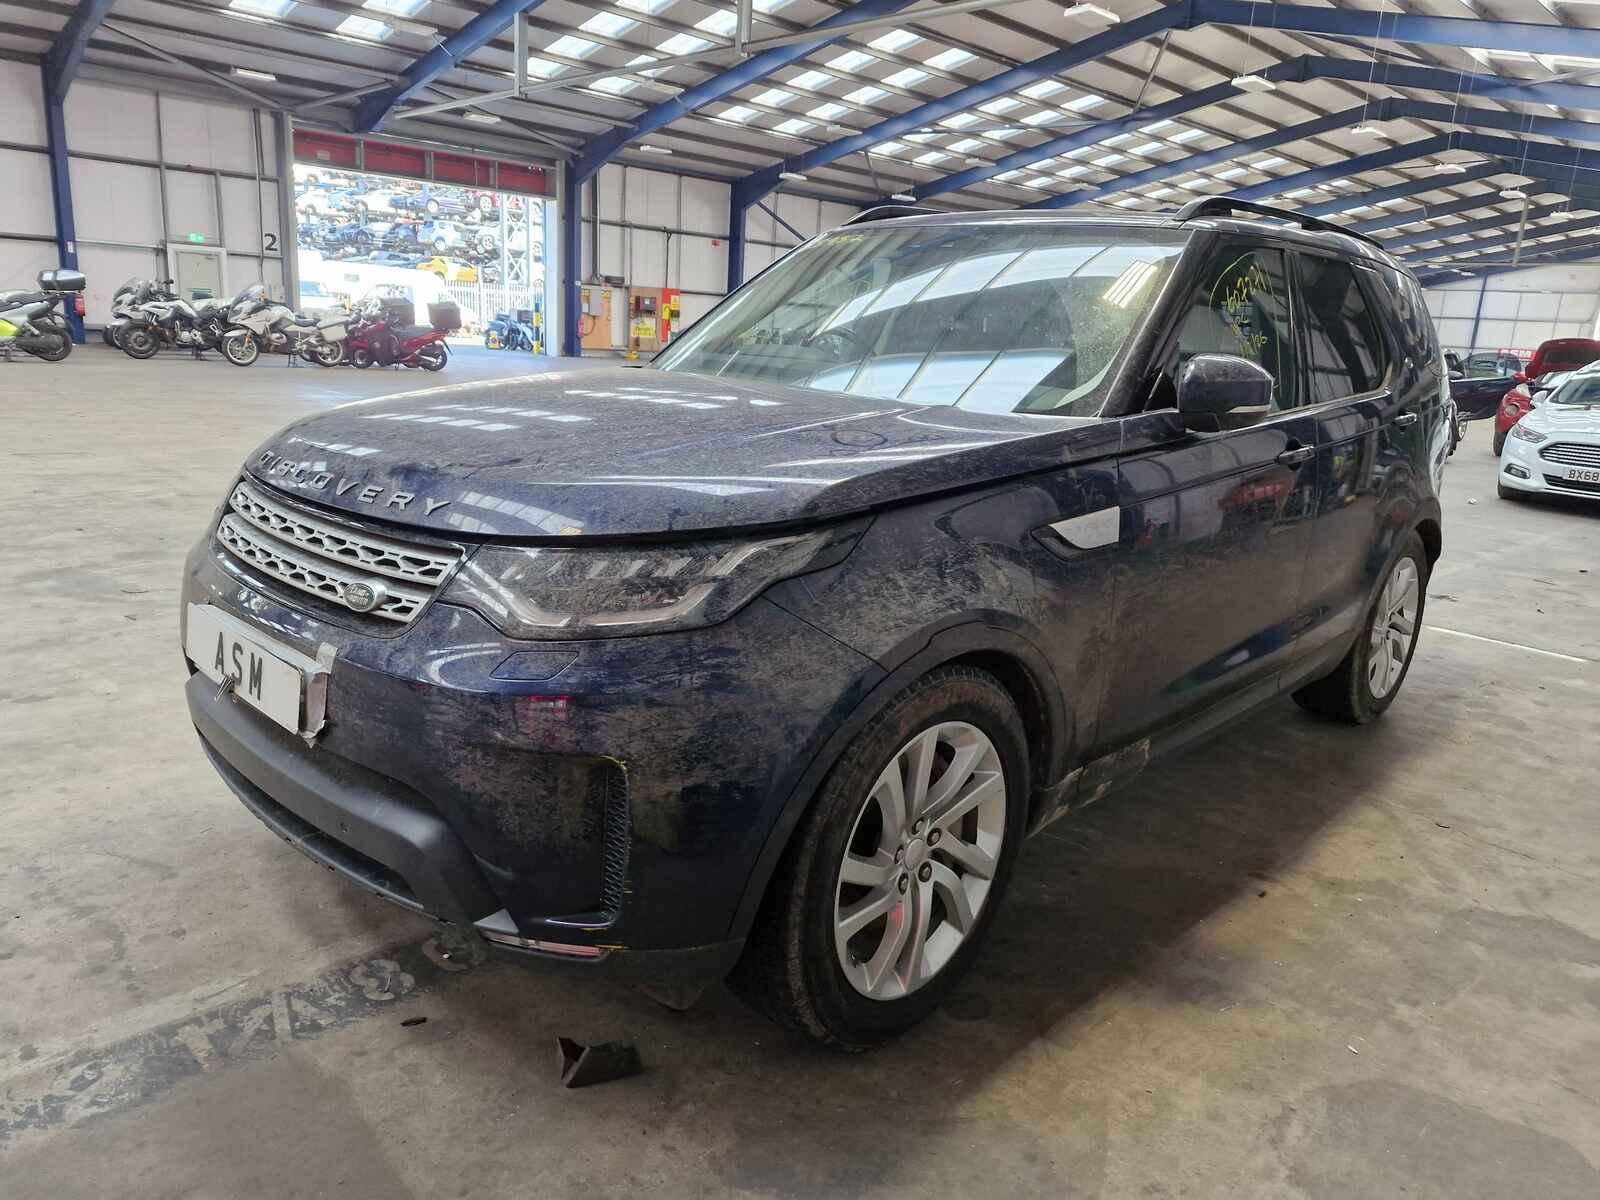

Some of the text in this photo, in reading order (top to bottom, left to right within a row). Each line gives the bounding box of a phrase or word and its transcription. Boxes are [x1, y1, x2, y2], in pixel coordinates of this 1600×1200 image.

[264, 233, 278, 251] 2
[259, 450, 451, 517] DISCOVERY
[214, 631, 263, 702] ASM
